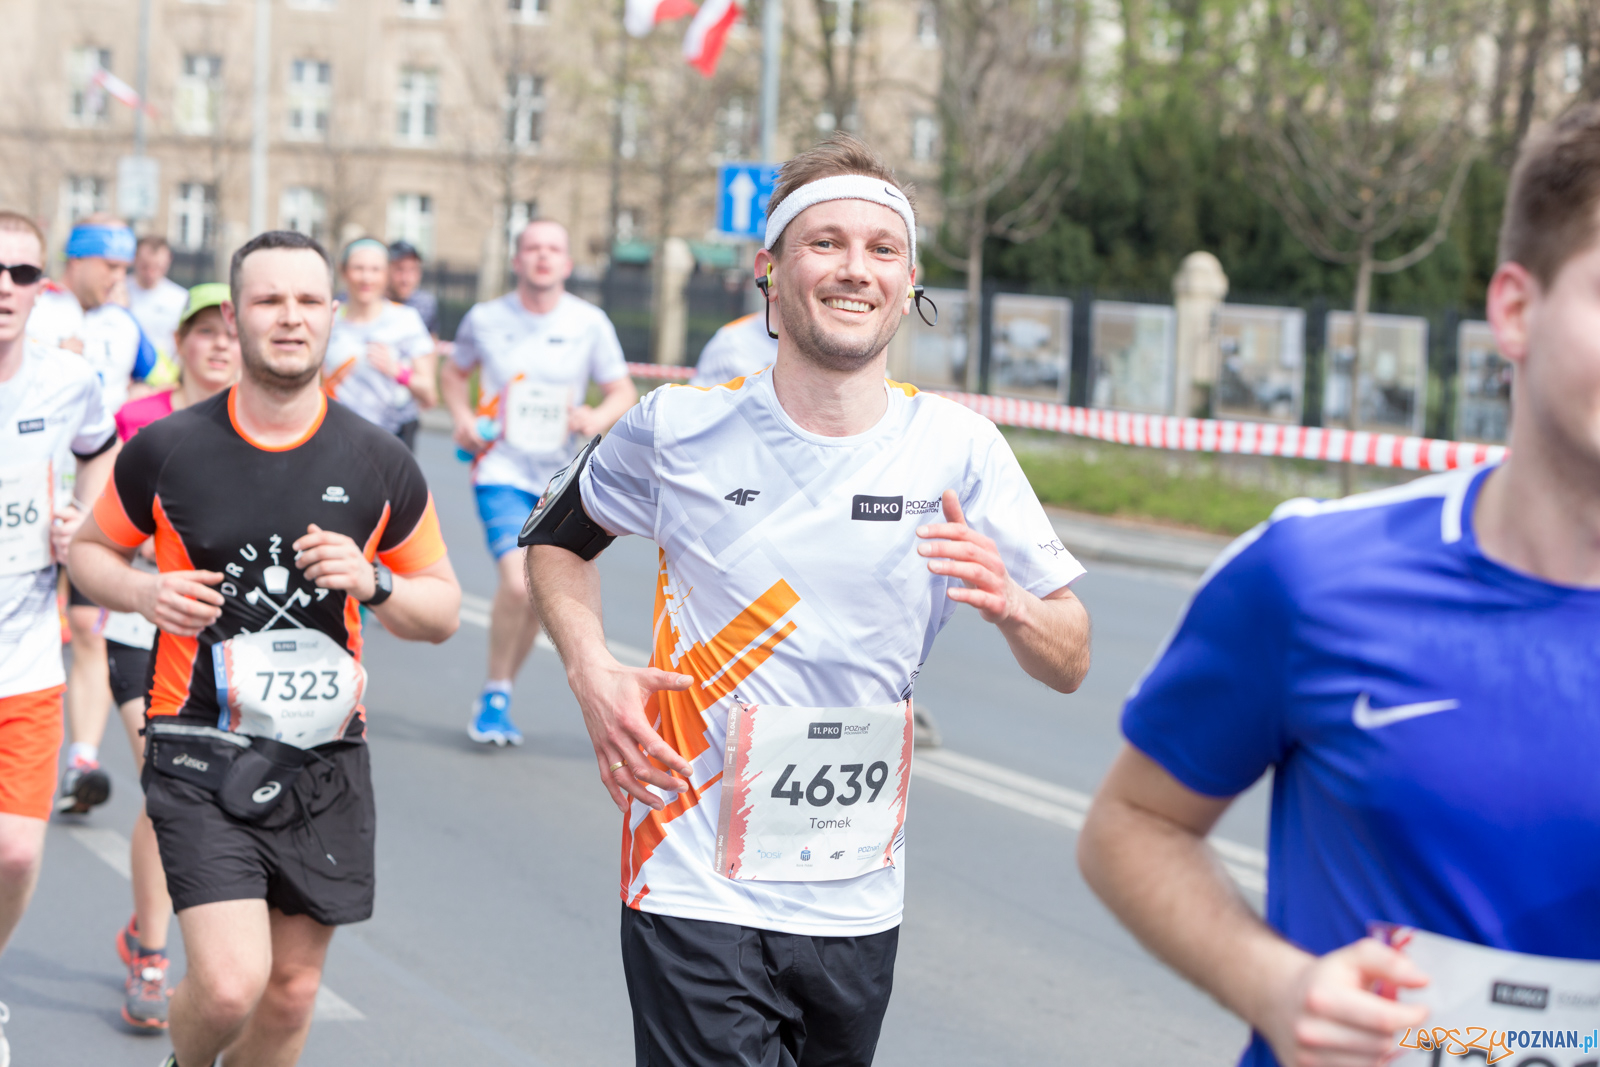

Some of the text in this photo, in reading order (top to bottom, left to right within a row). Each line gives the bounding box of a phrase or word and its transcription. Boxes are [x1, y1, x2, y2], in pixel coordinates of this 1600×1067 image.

[0, 499, 39, 528] 56
[256, 670, 339, 701] 7323
[770, 760, 889, 807] 4639
[809, 817, 852, 829] Tomek
